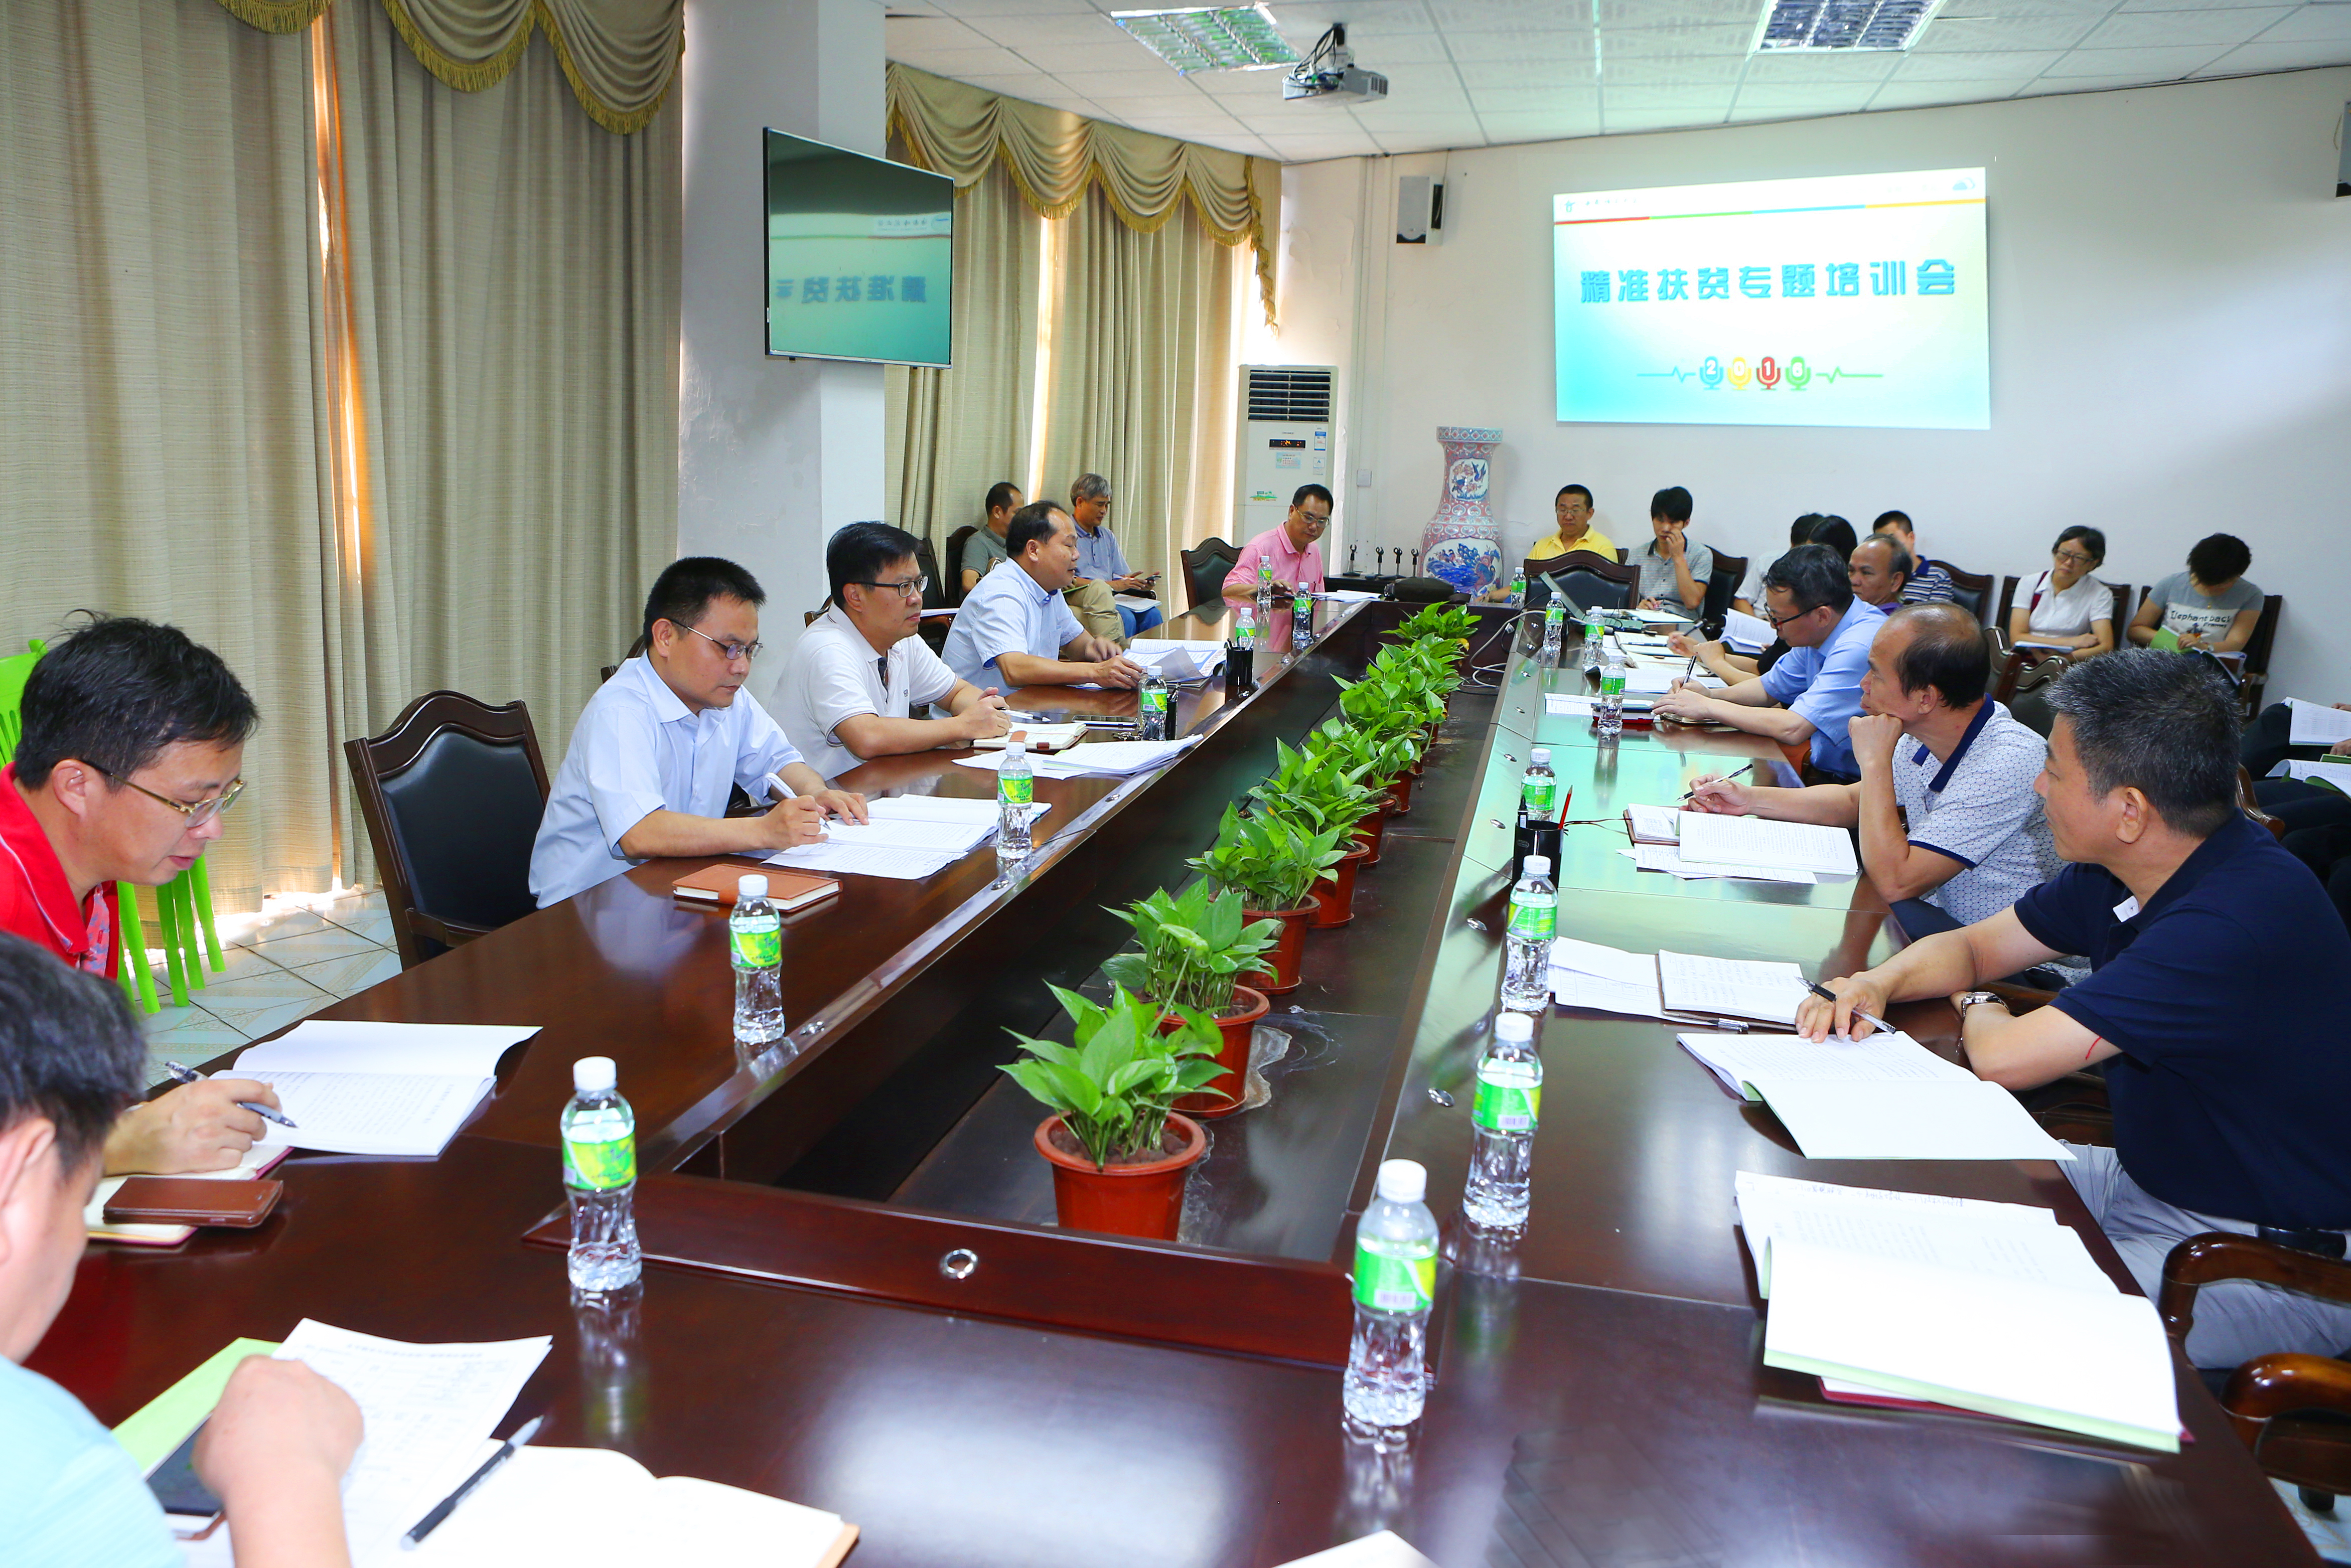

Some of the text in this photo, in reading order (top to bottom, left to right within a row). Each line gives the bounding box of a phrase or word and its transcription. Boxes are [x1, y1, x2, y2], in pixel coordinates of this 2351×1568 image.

[1581, 259, 1955, 302] 精准扶贫专题培训会
[1706, 359, 1803, 377] 2016
[2170, 610, 2208, 621] Elephant
